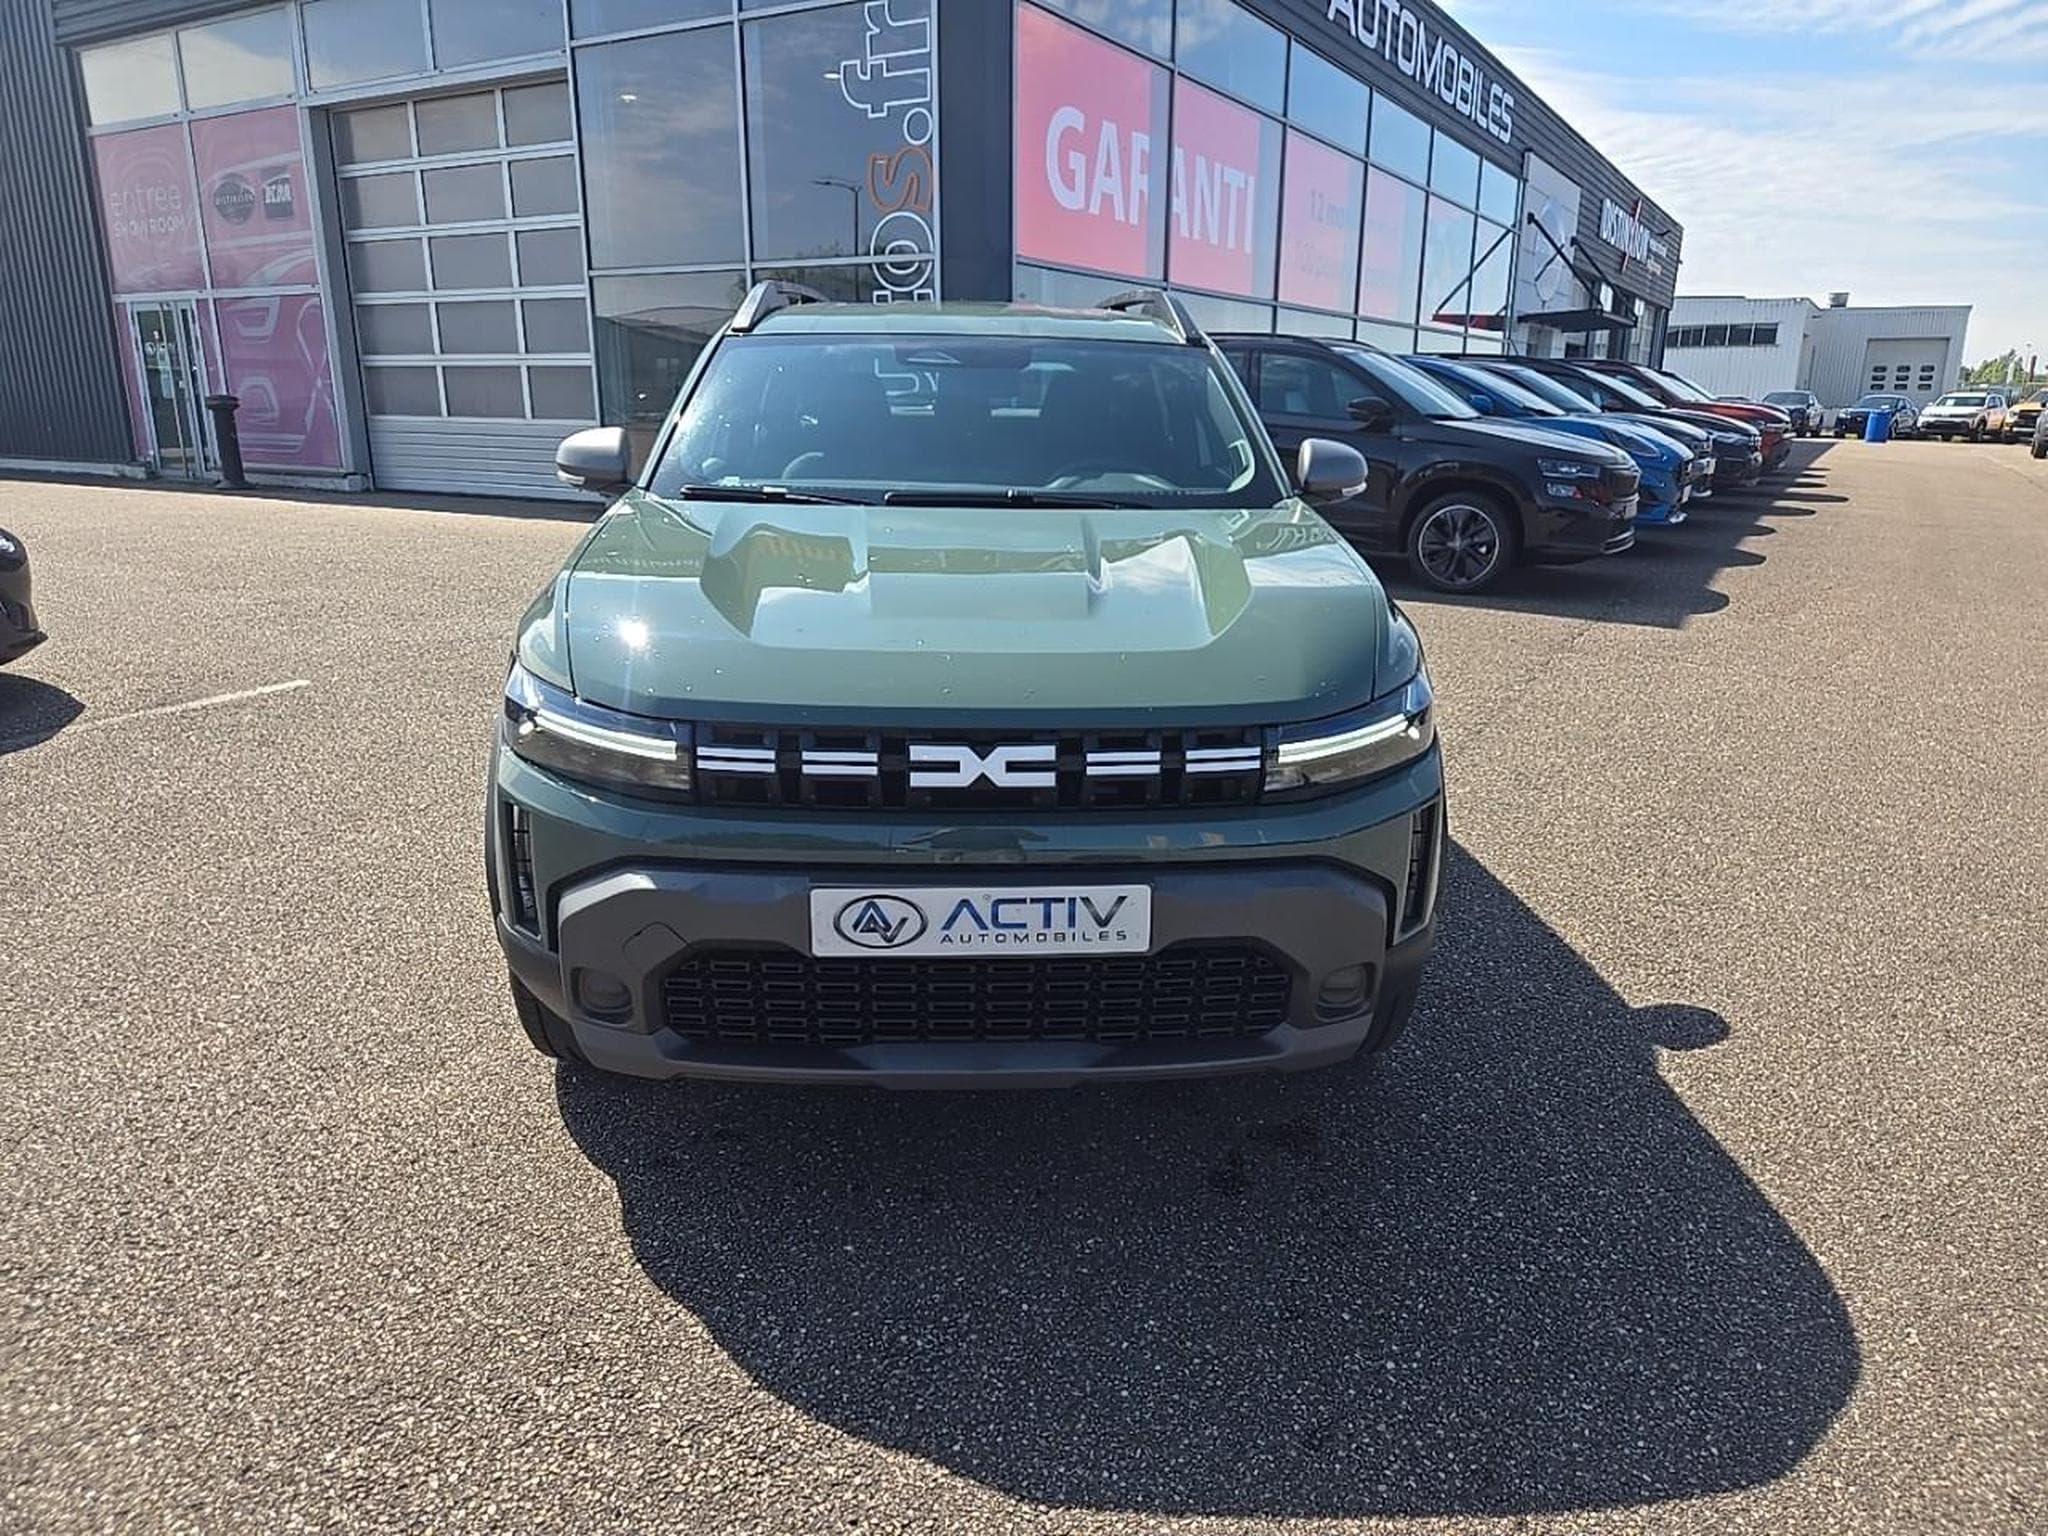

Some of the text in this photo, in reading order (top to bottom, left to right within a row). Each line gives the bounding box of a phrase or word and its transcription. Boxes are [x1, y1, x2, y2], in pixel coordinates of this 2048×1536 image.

[1327, 0, 1515, 144] AUTOMOBILES
[840, 0, 934, 305] os.fr
[939, 930, 1128, 945] AUTOMOBILES
[940, 895, 1129, 931] ACTIV
